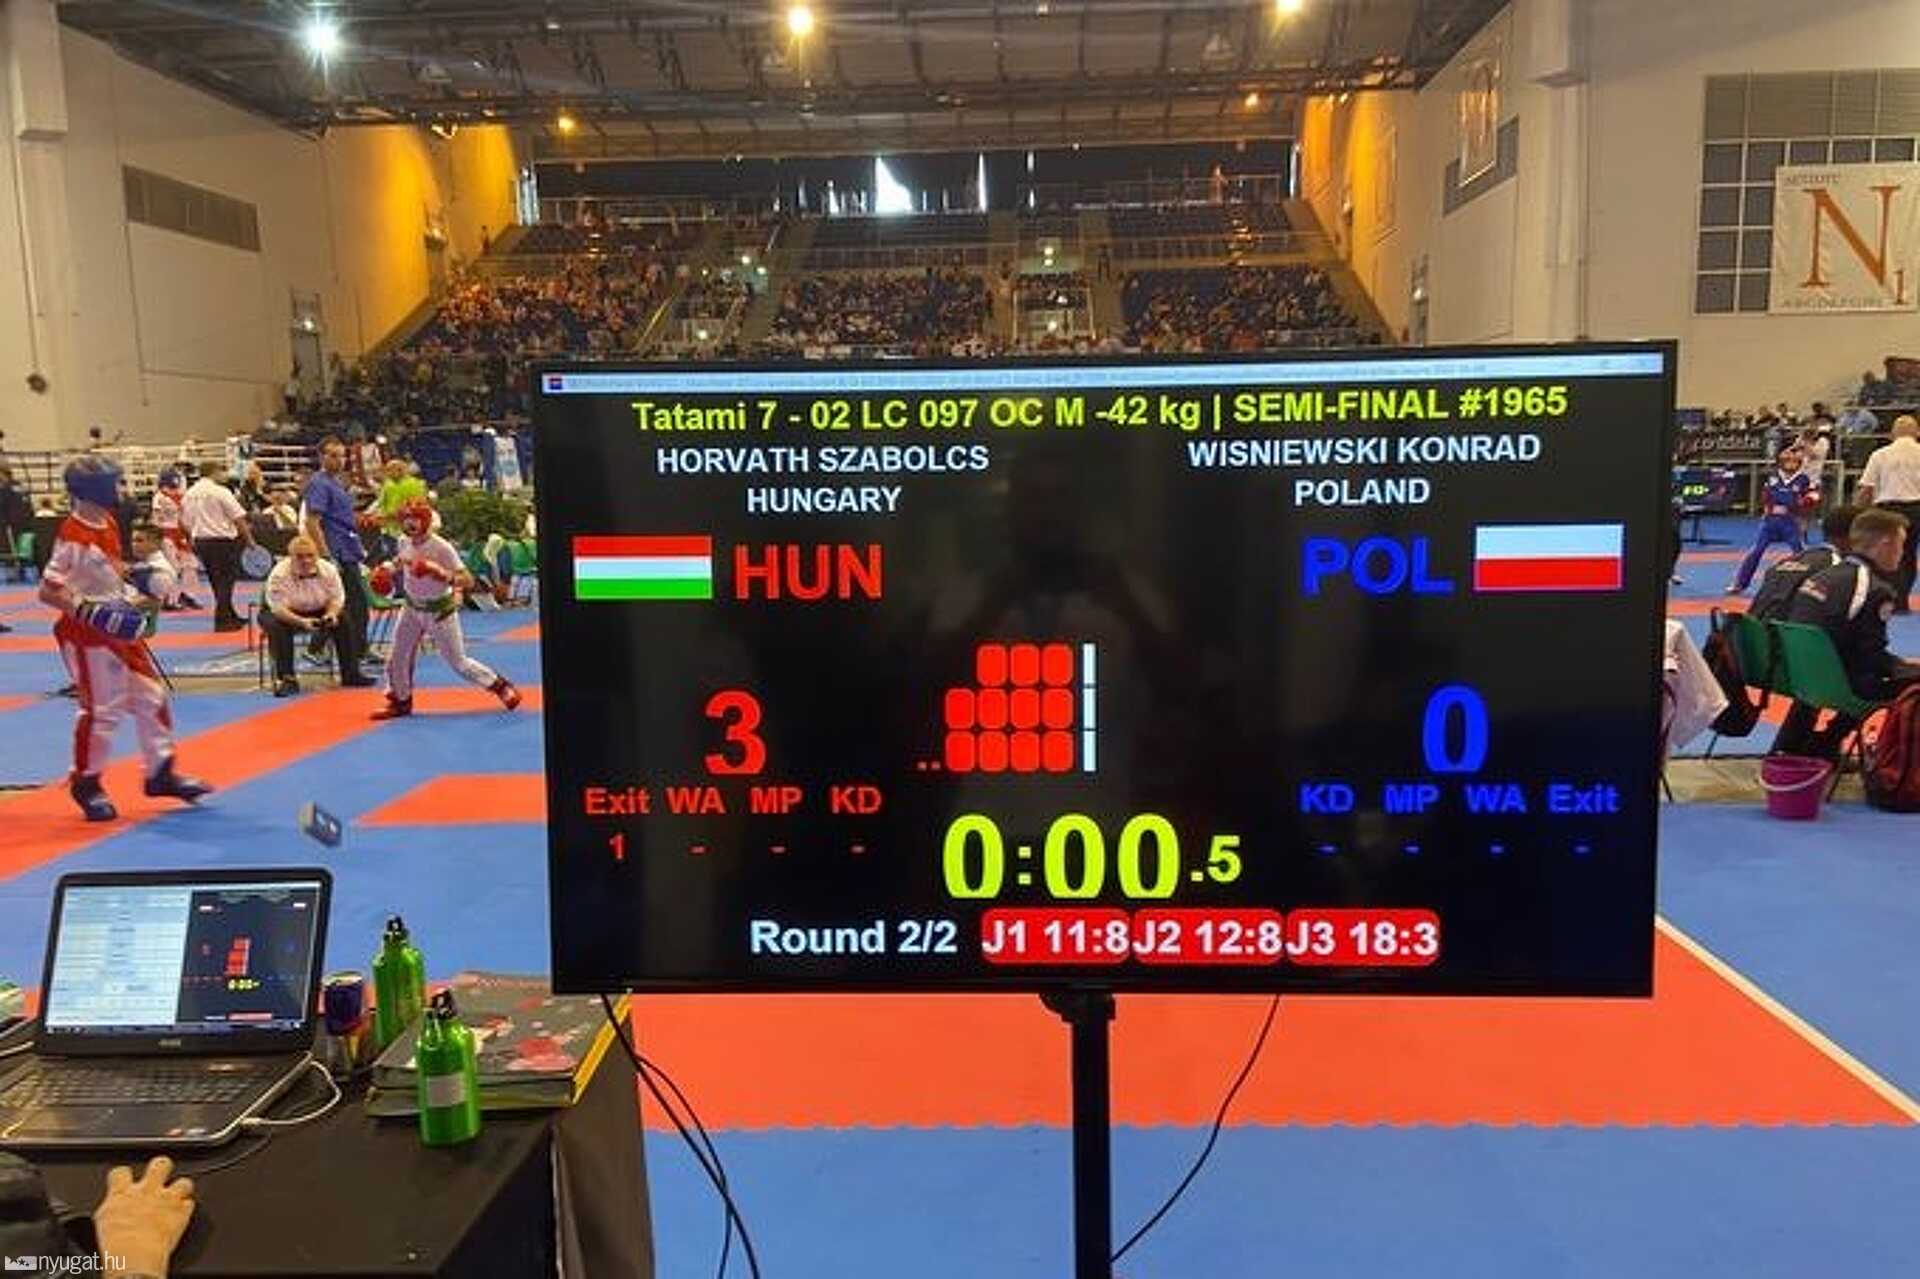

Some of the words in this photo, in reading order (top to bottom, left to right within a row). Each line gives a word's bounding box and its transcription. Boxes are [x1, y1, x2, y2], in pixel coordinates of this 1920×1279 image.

[632, 401, 746, 431] Tatami
[757, 400, 777, 430] 7
[810, 400, 851, 430] 02
[862, 399, 908, 430] LC
[919, 398, 979, 428] 097
[989, 397, 1044, 428] OC
[1055, 396, 1085, 427] M
[1095, 395, 1148, 425] -42
[1159, 395, 1201, 431] kg
[1233, 388, 1450, 423] SEMI-FINAL
[1458, 385, 1568, 418] #1965
[657, 447, 809, 474] HORVATH
[818, 445, 989, 473] SZABOLCS
[1187, 436, 1388, 468] WISNIEWSKI
[1398, 433, 1541, 464] KONRAD
[747, 486, 902, 513] HUNGARY
[1295, 478, 1431, 507] POLAND
[734, 544, 882, 600] HUN
[1302, 535, 1454, 596] POL
[705, 690, 767, 775] 3
[1422, 684, 1490, 774] 0
[585, 786, 650, 815] Exit
[666, 786, 725, 815] WA
[750, 786, 802, 815] MP
[831, 786, 882, 815] KD
[1300, 783, 1355, 813] KD
[1384, 783, 1440, 813] MP
[1465, 783, 1527, 813] WA
[1548, 783, 1619, 814] Exit
[609, 834, 624, 860] 1
[750, 919, 886, 954] Round
[897, 919, 958, 954] 2/2
[982, 920, 1027, 954] J1
[1043, 920, 1129, 954] 11:8
[1132, 920, 1182, 954] J2
[1194, 921, 1282, 955] 12:8
[1285, 921, 1337, 956] J3
[1349, 922, 1439, 957] 18:3
